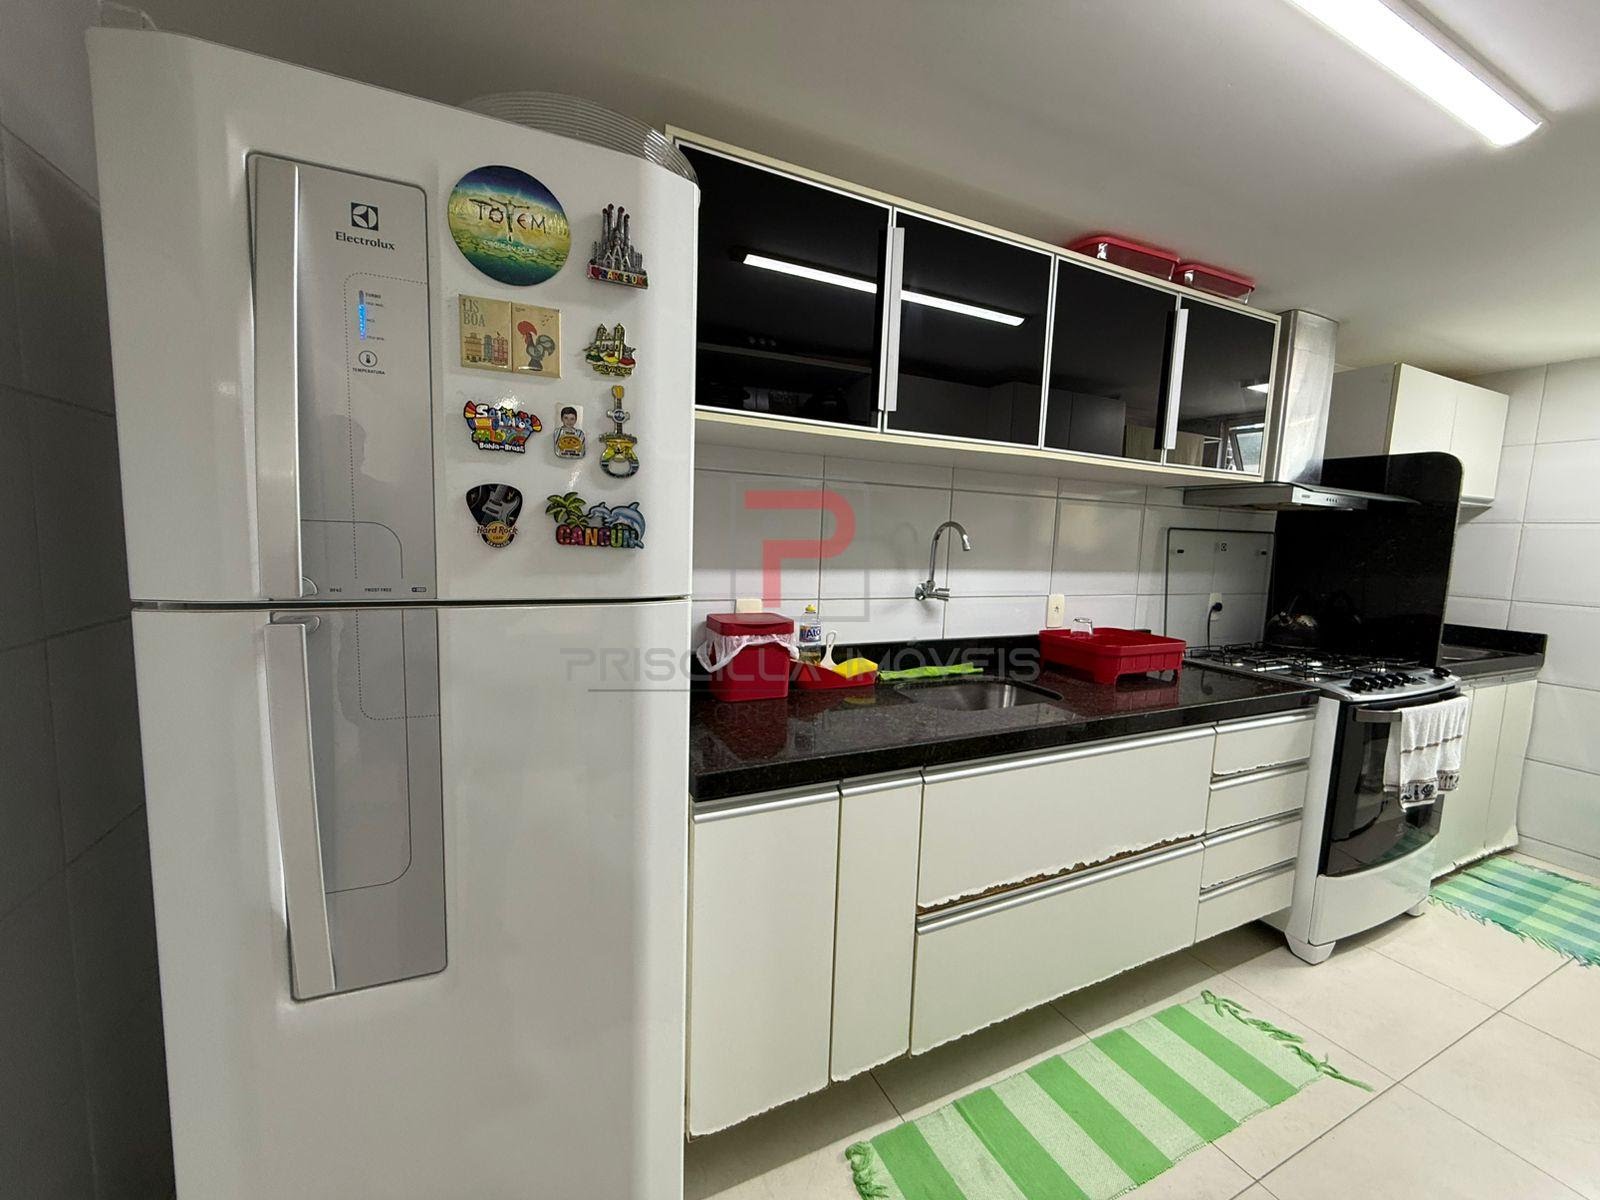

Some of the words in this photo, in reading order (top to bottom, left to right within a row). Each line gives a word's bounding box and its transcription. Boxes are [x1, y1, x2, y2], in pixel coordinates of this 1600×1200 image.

[469, 198, 547, 242] TOTEM
[335, 231, 395, 250] Electrolux
[463, 299, 480, 313] LIS
[463, 312, 486, 327] BOA
[477, 525, 498, 534] Hard
[498, 525, 519, 535] Rock
